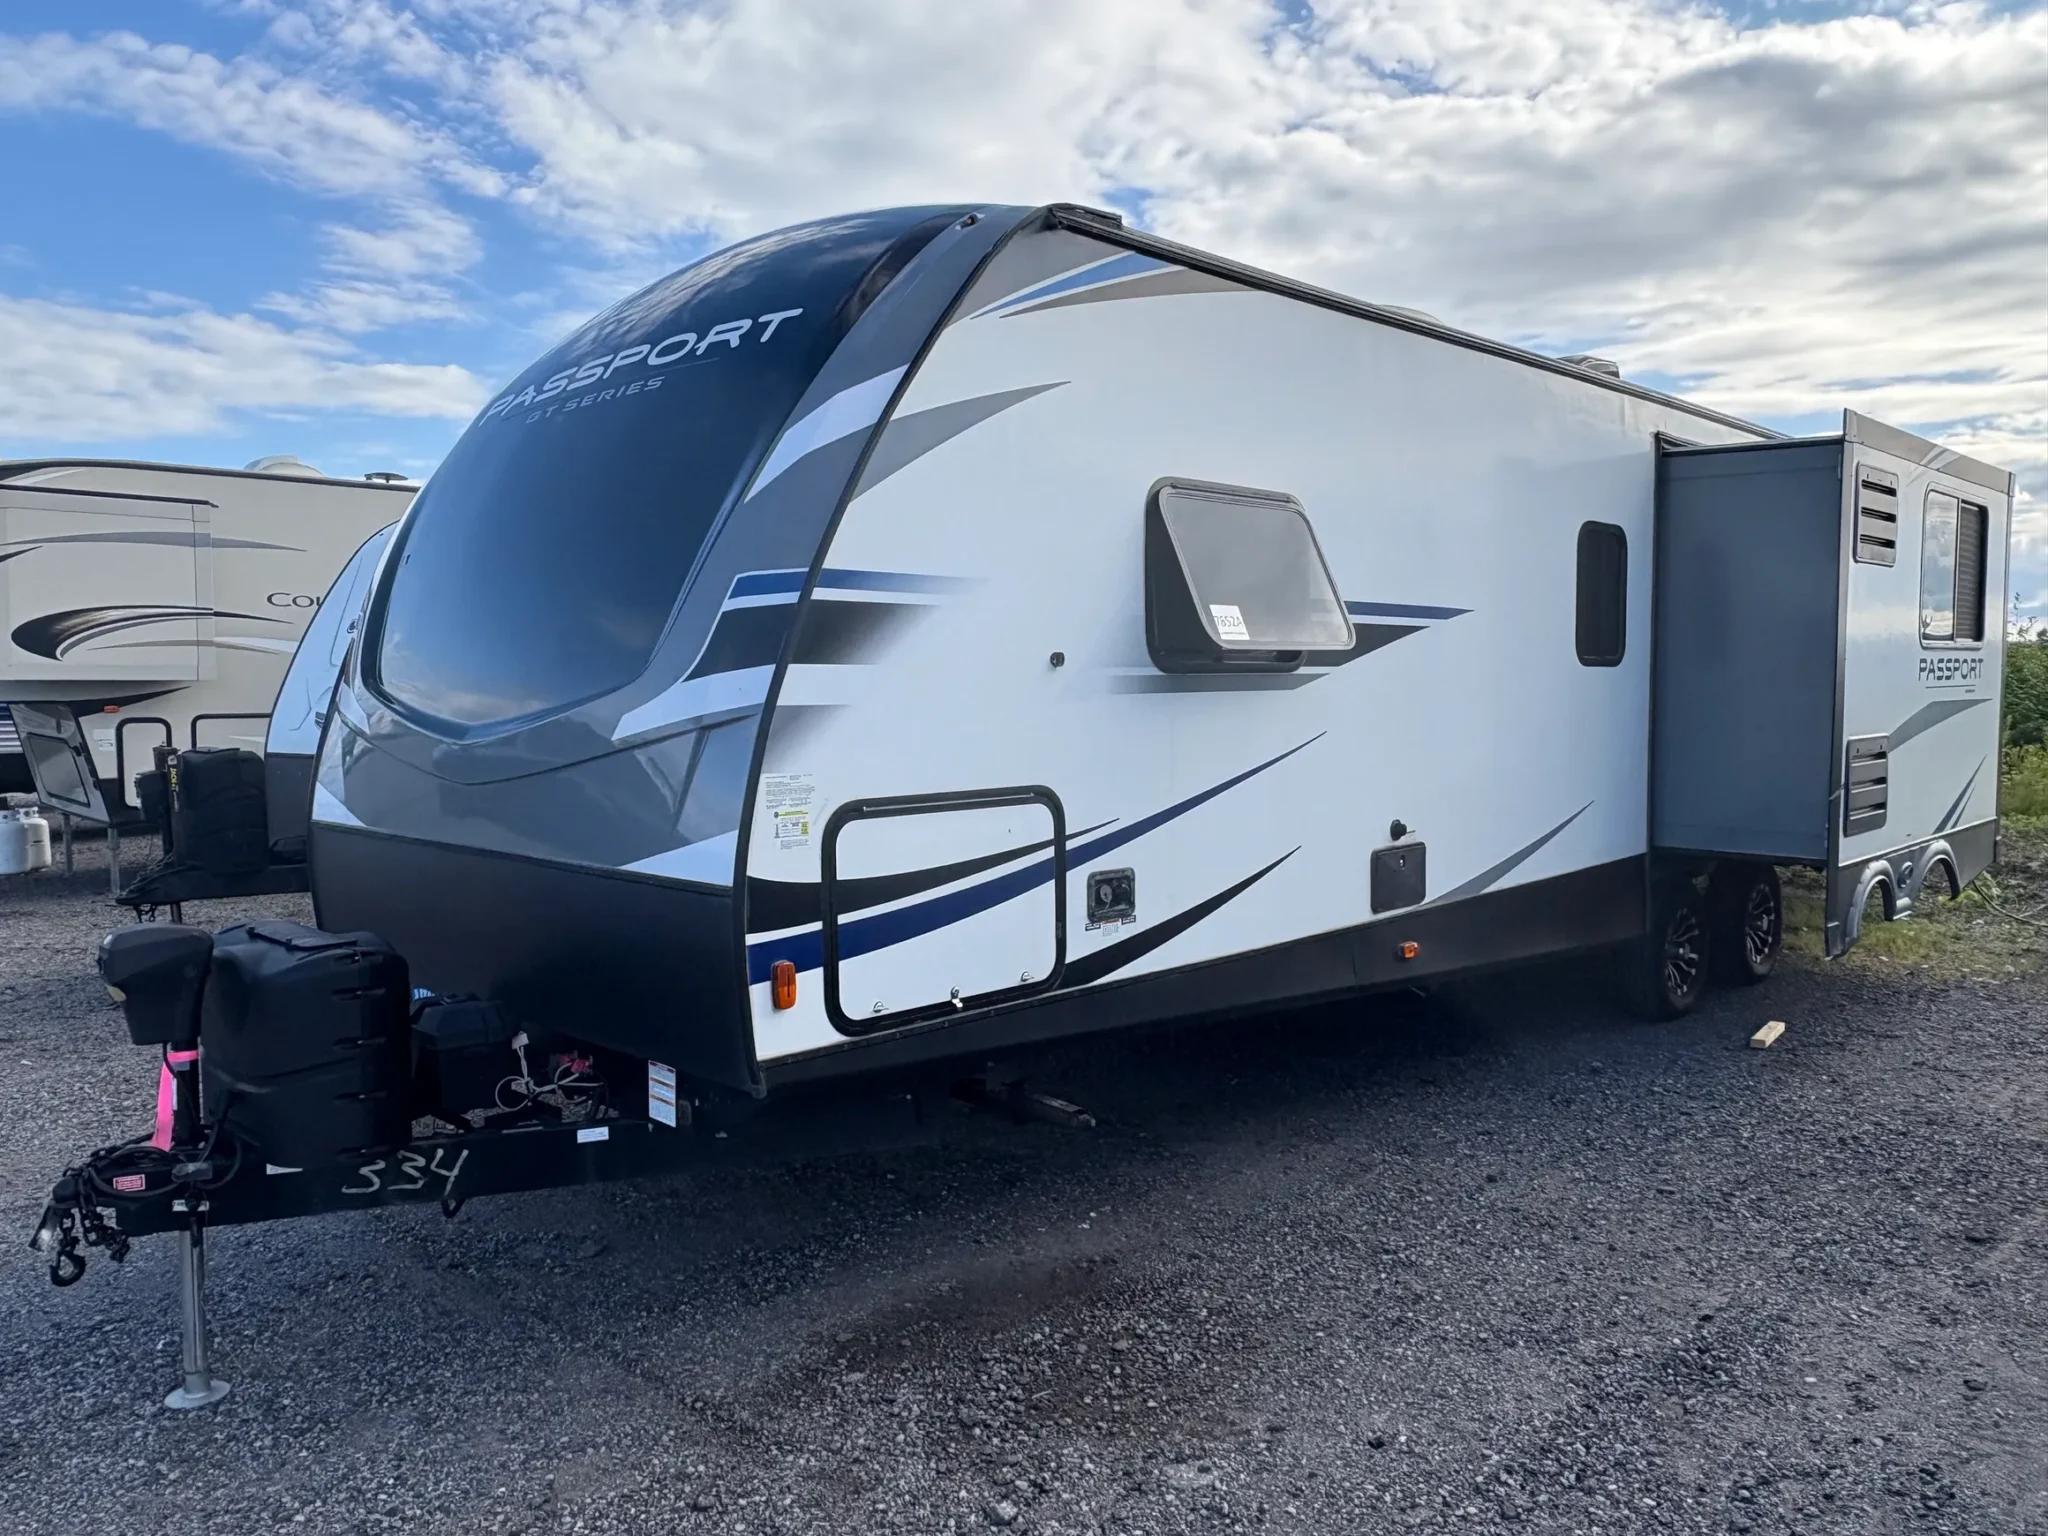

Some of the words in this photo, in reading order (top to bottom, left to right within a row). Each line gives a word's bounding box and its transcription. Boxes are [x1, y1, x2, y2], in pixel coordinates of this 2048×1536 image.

[478, 308, 803, 427] PASSPORT
[525, 405, 559, 424] GT
[562, 376, 666, 412] SERIES
[1918, 658, 1984, 681] PASSPORT
